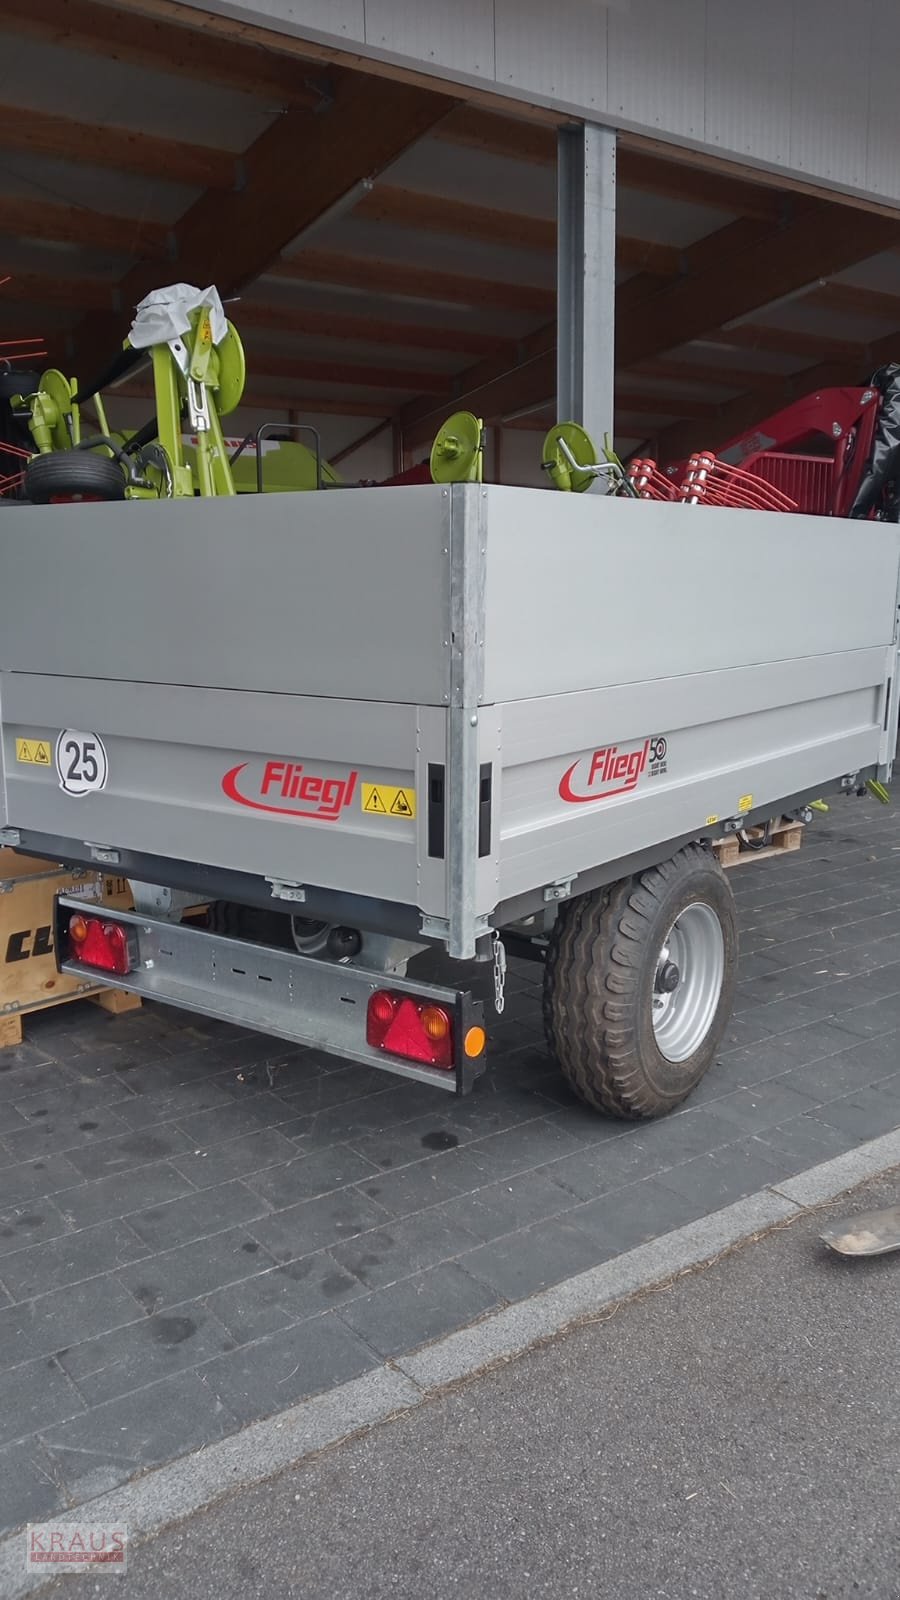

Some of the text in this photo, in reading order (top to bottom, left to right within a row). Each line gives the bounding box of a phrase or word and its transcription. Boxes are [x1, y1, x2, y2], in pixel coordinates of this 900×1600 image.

[65, 740, 98, 782] 25
[587, 739, 650, 786] Fliegl
[649, 737, 667, 763] 50
[260, 761, 358, 813] Fliegl
